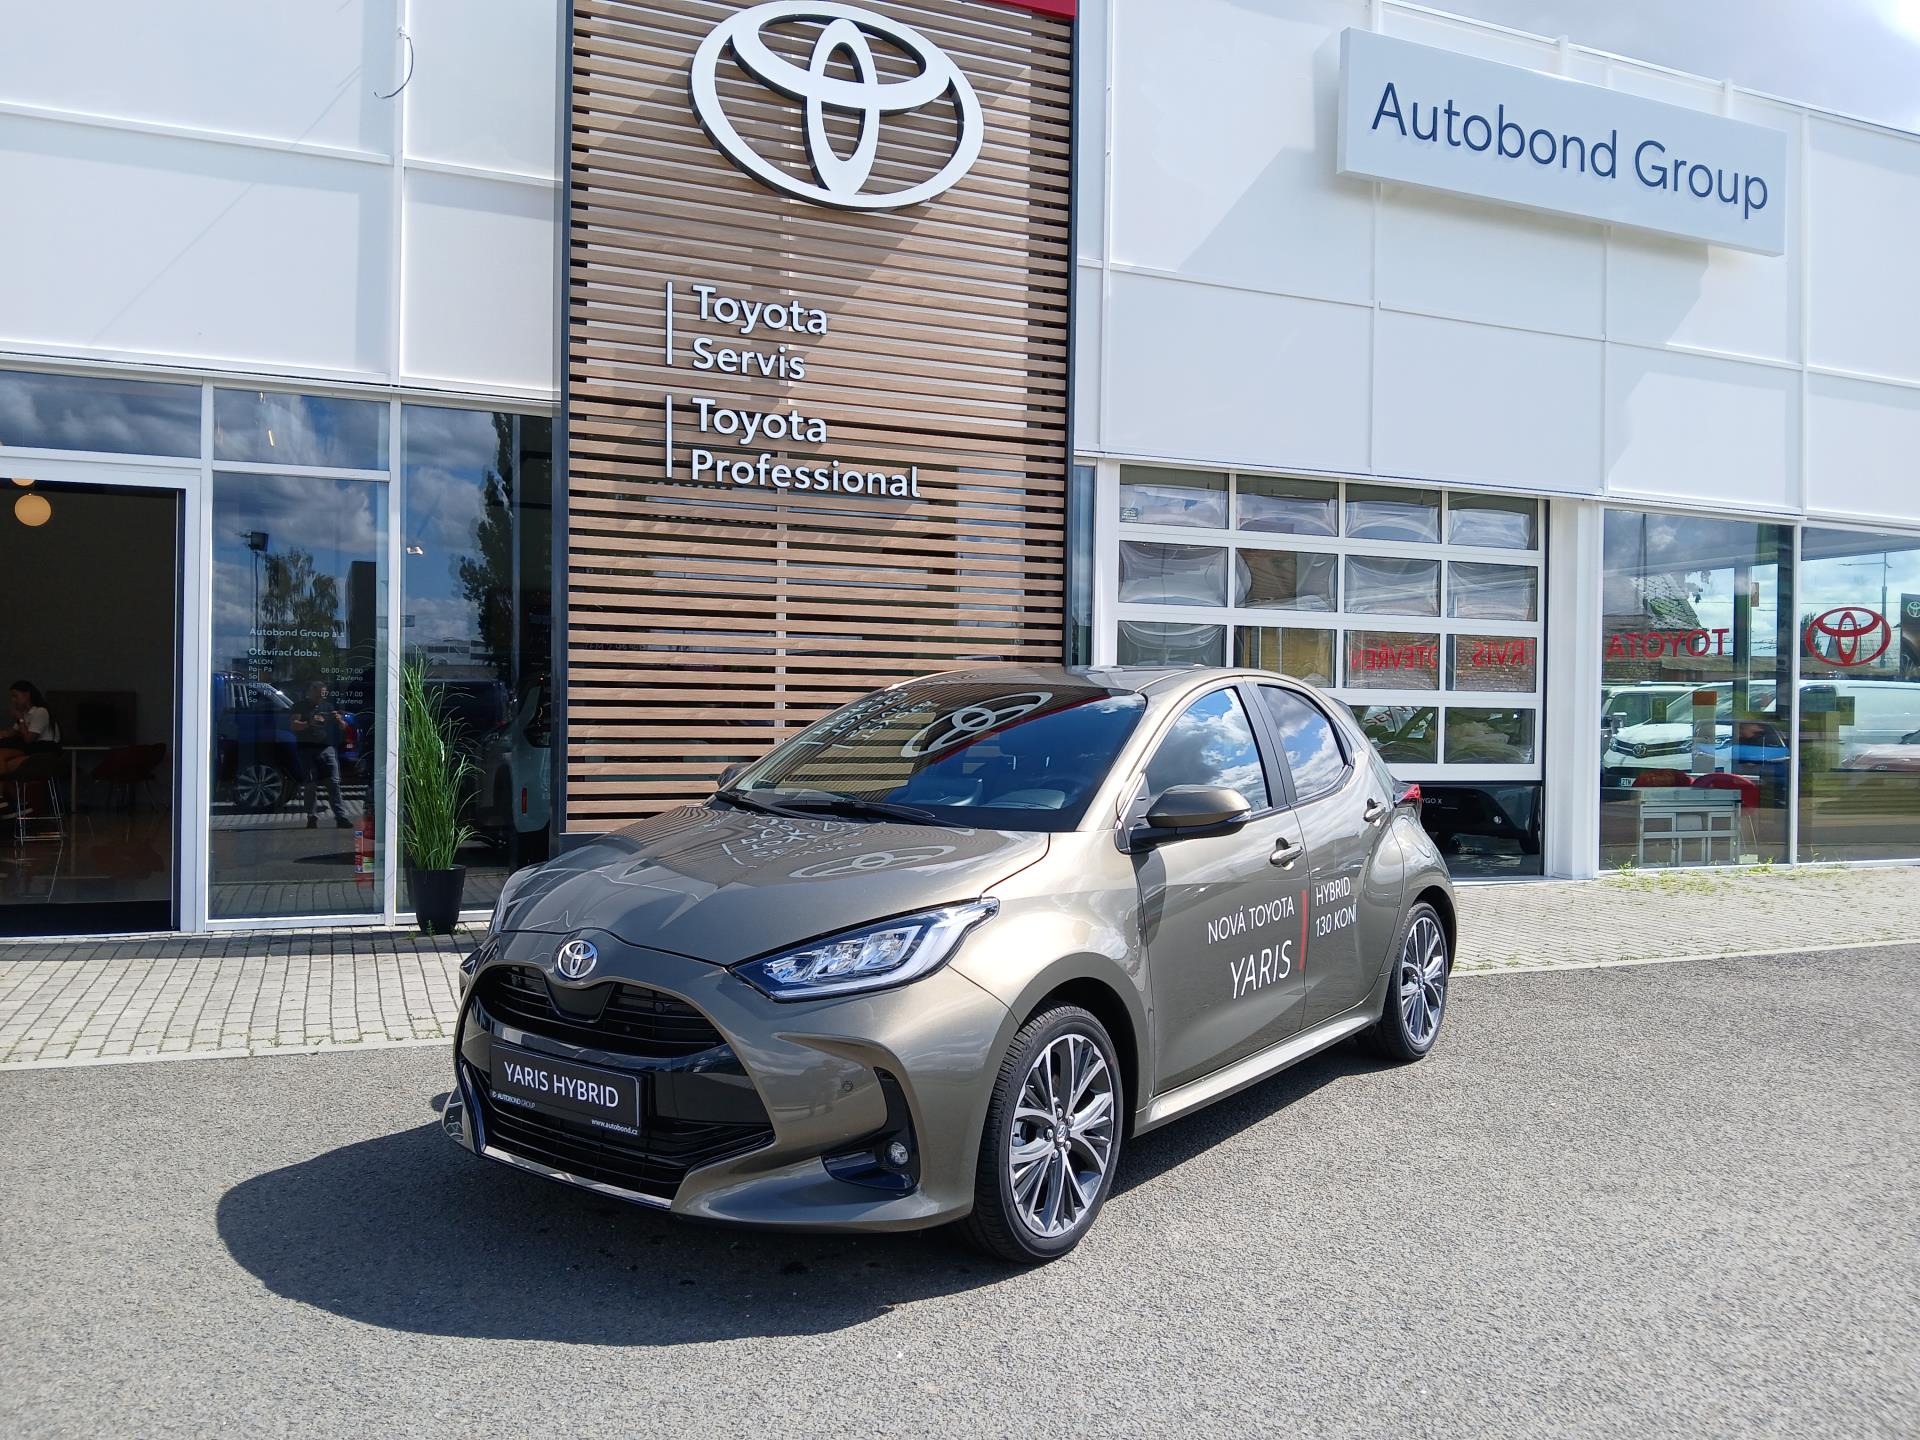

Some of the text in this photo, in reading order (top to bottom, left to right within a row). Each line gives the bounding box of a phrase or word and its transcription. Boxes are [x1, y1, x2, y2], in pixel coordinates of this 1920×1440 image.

[1371, 81, 1768, 220] Autobond Group
[691, 284, 829, 335] Toyota
[692, 337, 807, 380] Servis
[691, 397, 828, 445] Toyota
[690, 448, 921, 498] Professional
[248, 645, 321, 657] Otevírací doba:
[249, 627, 298, 637] Autobond
[299, 629, 330, 639] Group
[1315, 876, 1351, 907] HYBRID
[1207, 896, 1295, 945] NOVÁ TOYOTA
[1315, 898, 1358, 938] 130 KONÍ
[1230, 939, 1293, 999] YARIS
[503, 1061, 619, 1108] YARIS HYBRID
[591, 1118, 639, 1136] www.autobond.cz
